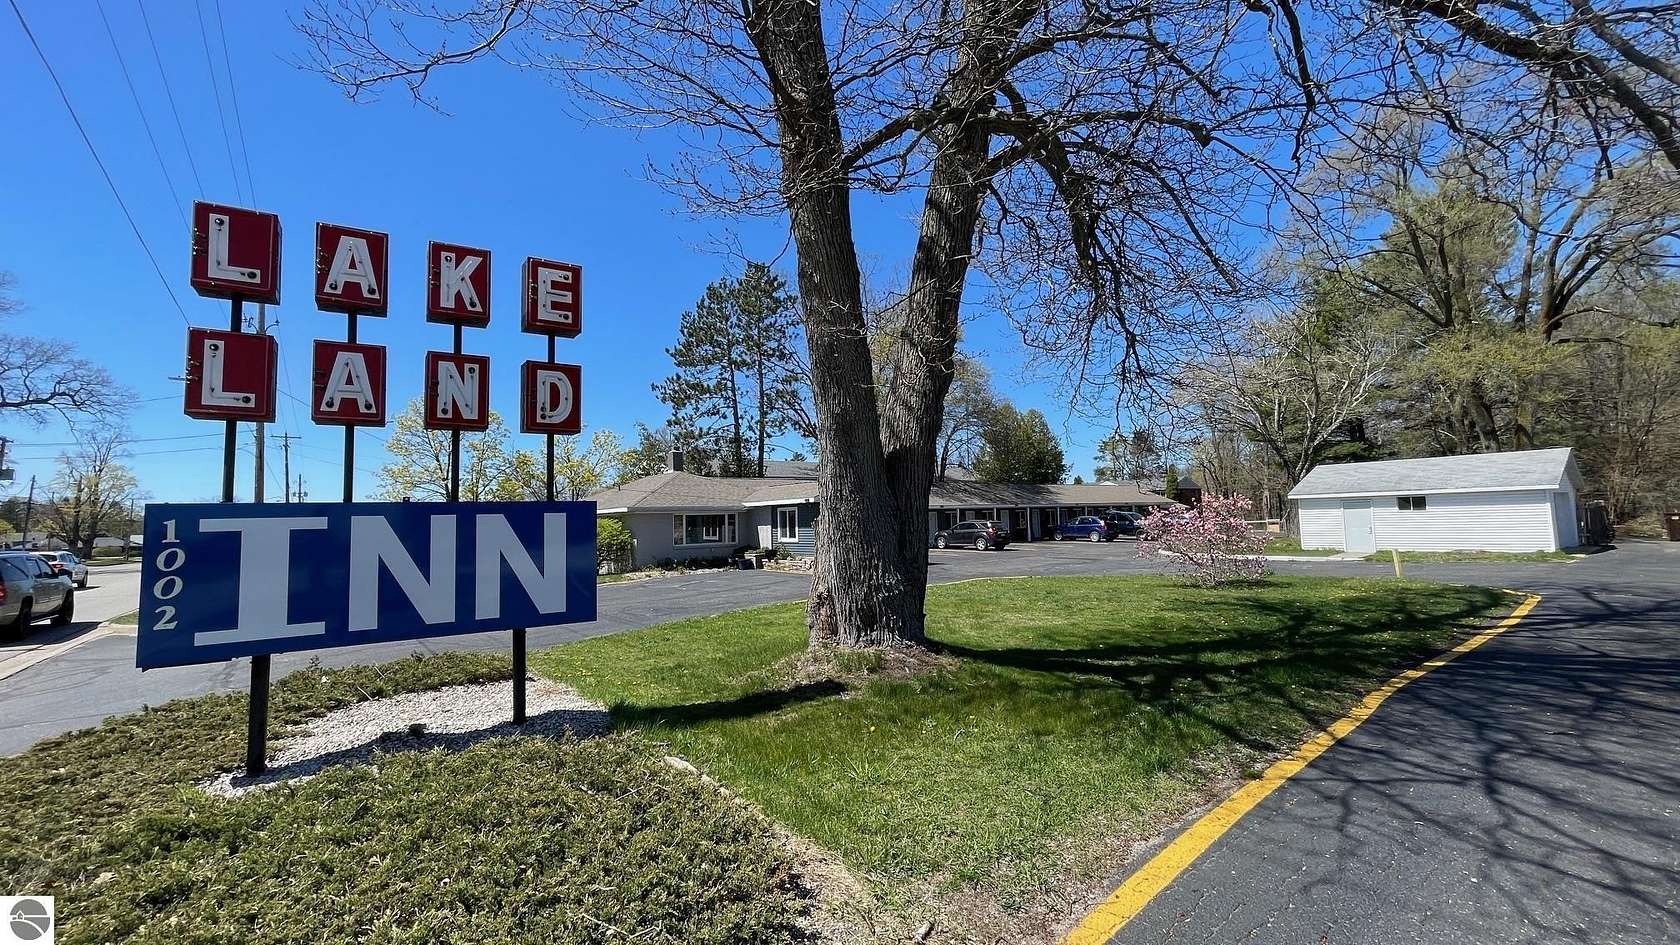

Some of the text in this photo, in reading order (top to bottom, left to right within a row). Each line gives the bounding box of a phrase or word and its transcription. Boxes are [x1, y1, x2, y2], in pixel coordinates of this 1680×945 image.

[208, 213, 572, 324] LAKE
[201, 339, 573, 424] LAND
[153, 519, 186, 631] 1002
[194, 512, 567, 647] INN
